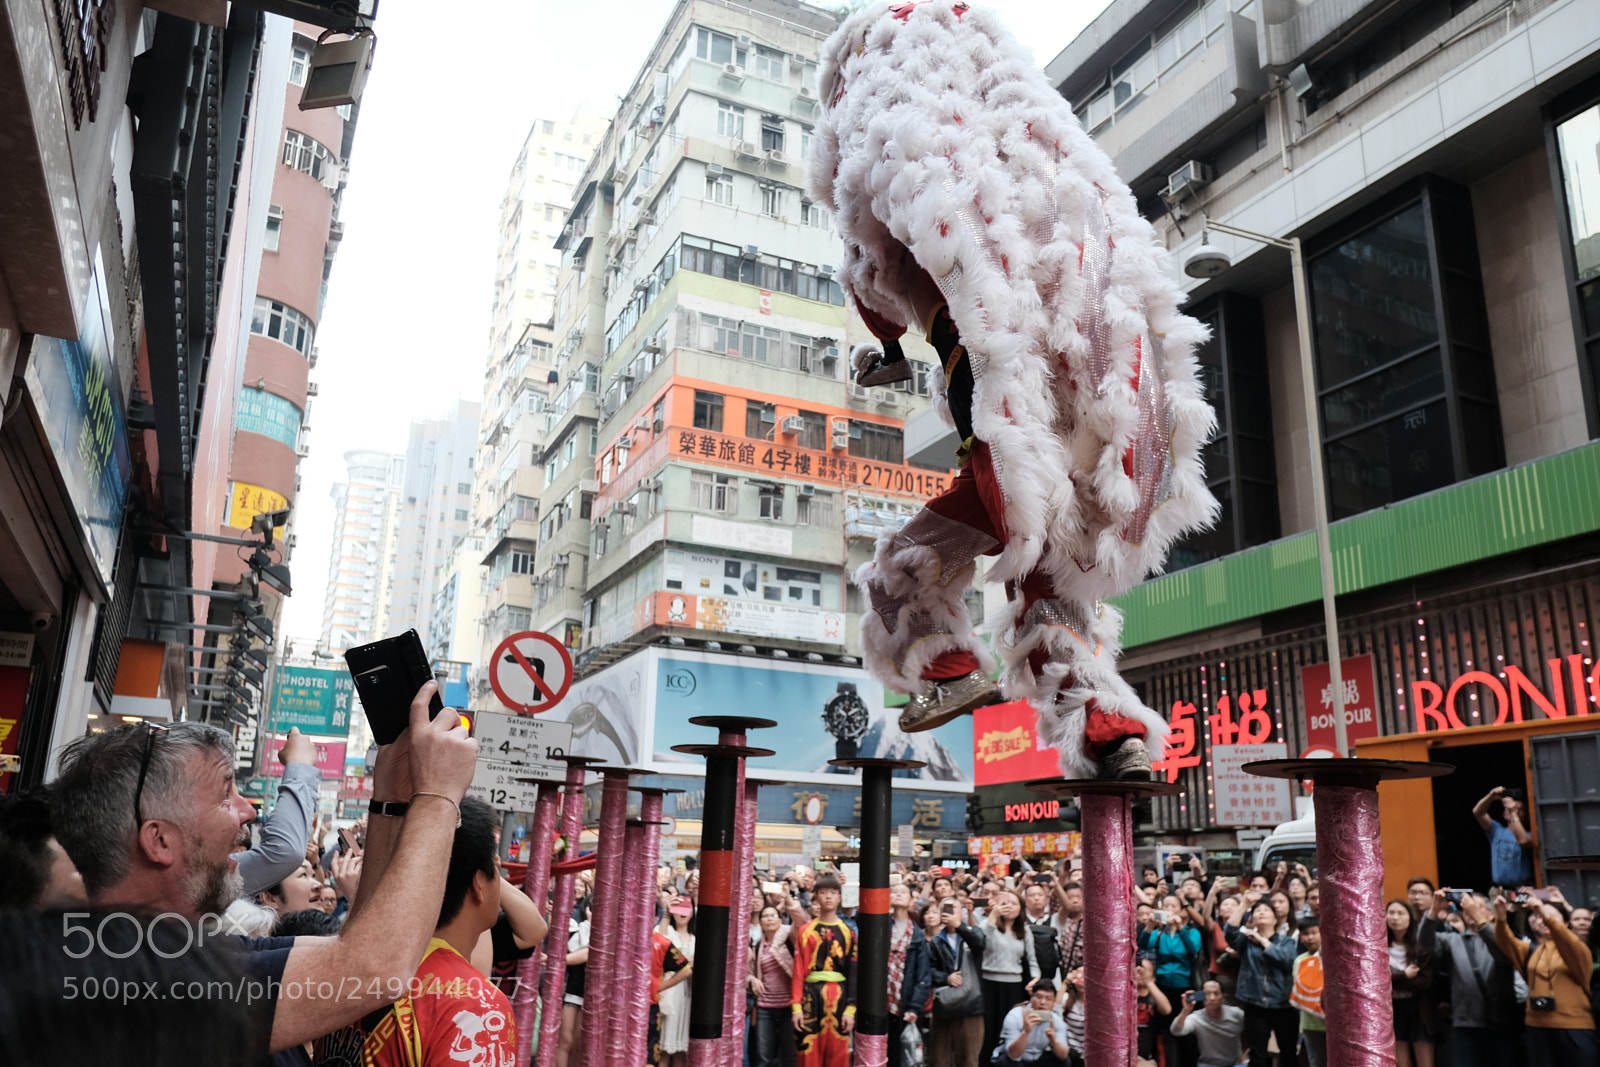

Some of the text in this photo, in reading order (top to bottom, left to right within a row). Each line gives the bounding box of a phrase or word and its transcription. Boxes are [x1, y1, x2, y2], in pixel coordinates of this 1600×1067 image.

[96, 388, 116, 467] CITY
[679, 431, 811, 476] 榮華旅館 4字樓
[863, 464, 944, 498] 27700155
[691, 555, 720, 565] SONY
[290, 676, 329, 689] HOSTEL
[507, 717, 544, 728] Saturdays
[509, 727, 539, 740] 星期六
[479, 745, 541, 761] 下午 下午
[546, 746, 564, 759] 10
[487, 763, 548, 777] General Holidays
[1228, 783, 1275, 793] 停車等候
[1230, 797, 1276, 807] 會被檢控
[1005, 800, 1060, 823] BONJOUR
